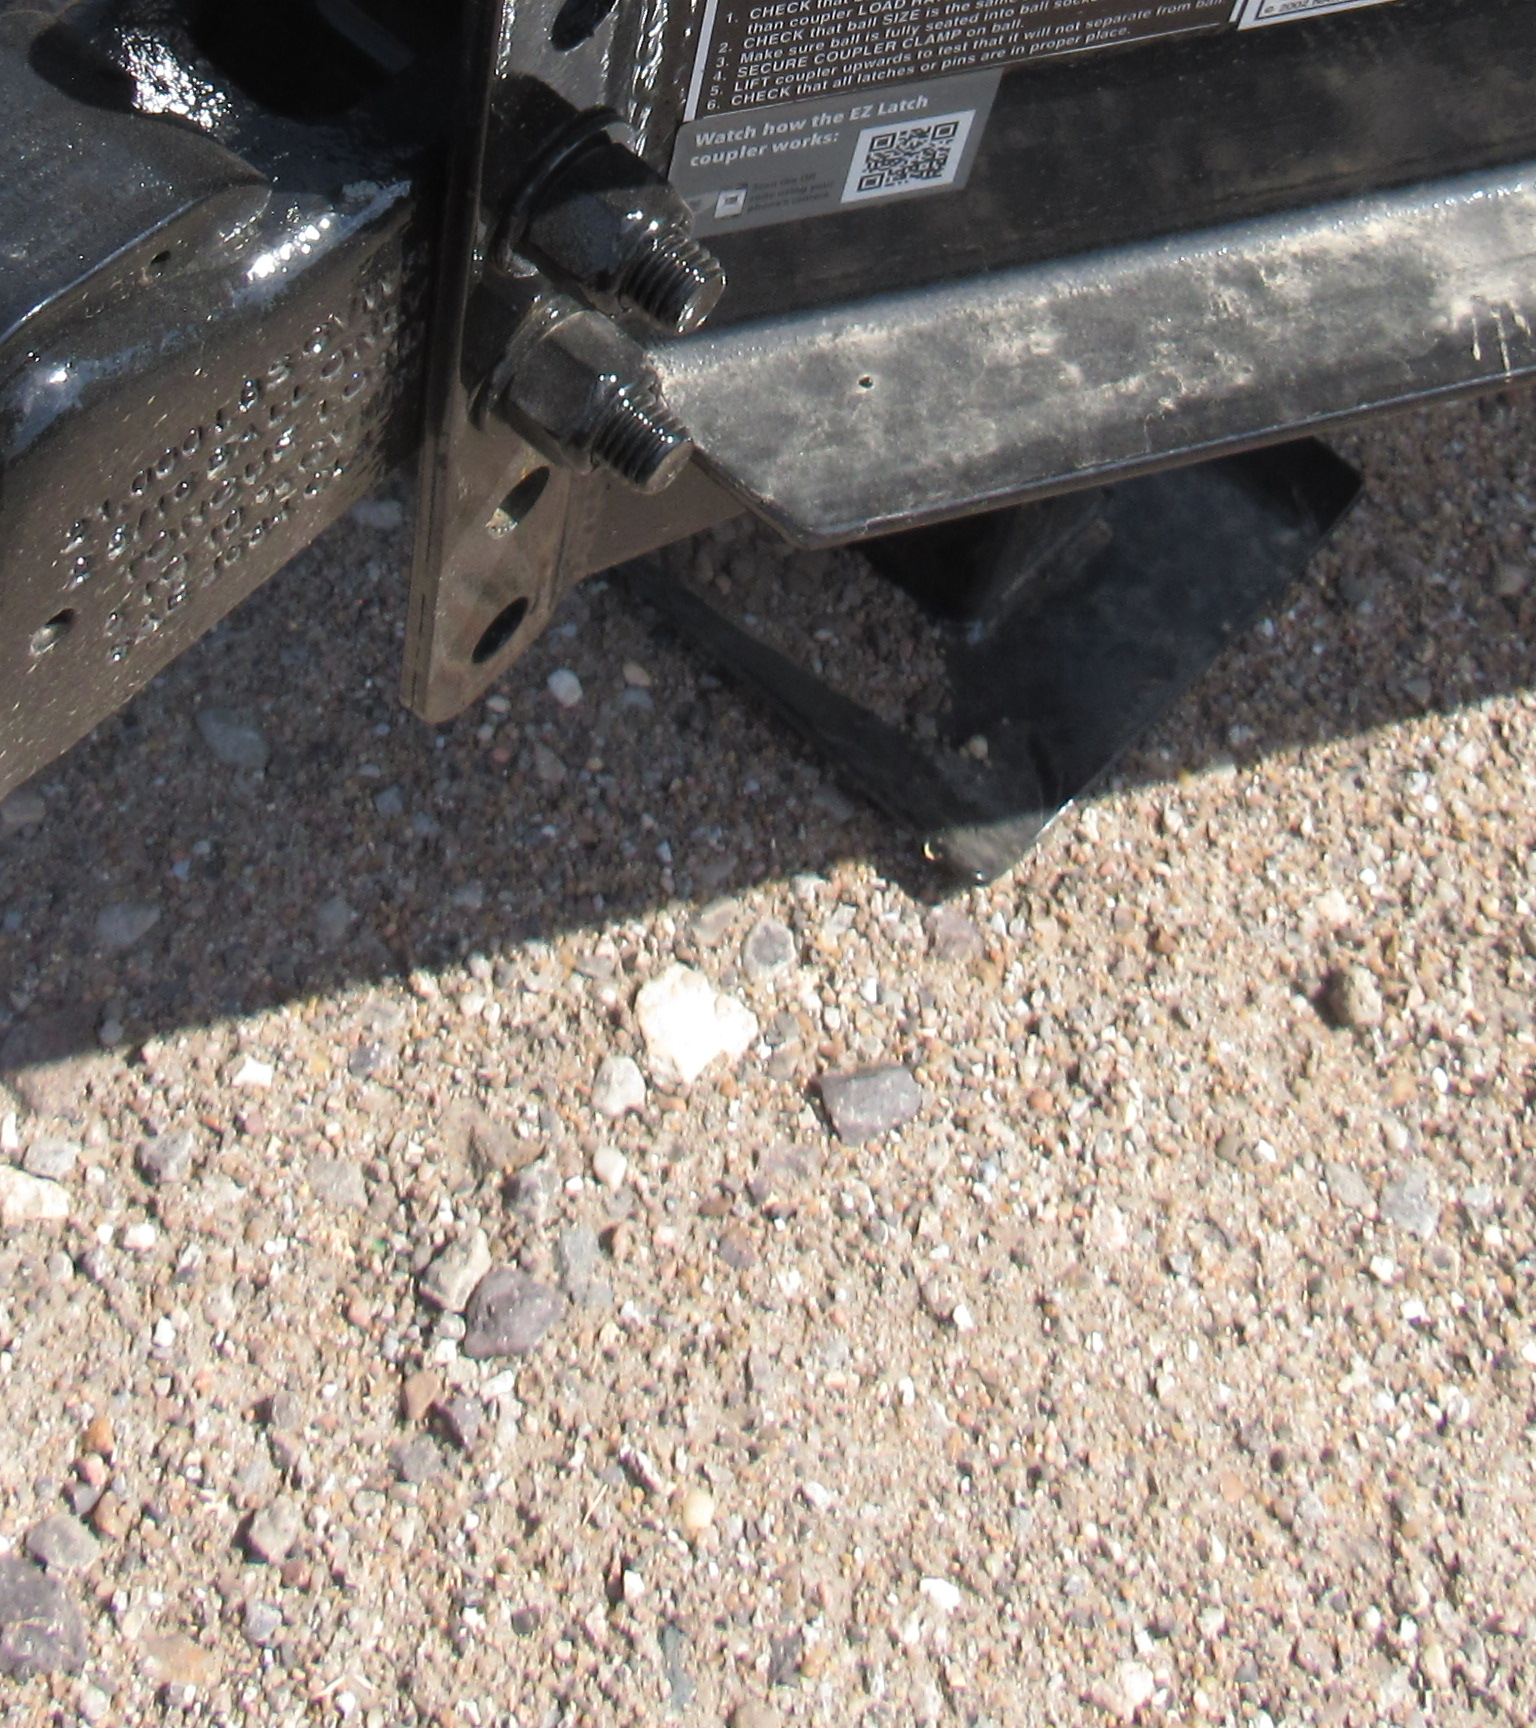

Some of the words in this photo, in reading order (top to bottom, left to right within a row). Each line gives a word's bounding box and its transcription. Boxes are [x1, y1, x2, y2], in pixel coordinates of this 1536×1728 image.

[715, 56, 729, 68] 3.
[739, 48, 783, 63] Make
[788, 41, 825, 55] sure
[829, 33, 860, 48] ball
[864, 31, 879, 42] is
[884, 24, 919, 38] fully
[925, 13, 979, 31] seated
[983, 8, 1015, 21] into
[1019, 0, 1049, 15] ball
[717, 41, 732, 54] 2.
[743, 29, 803, 49] CHECK
[809, 22, 841, 38] that
[846, 16, 877, 31] ball
[882, 8, 920, 25] SIZE
[924, 7, 939, 18] is
[944, 2, 970, 15] the
[727, 11, 738, 24] 1.
[749, 0, 810, 19] CHECK
[747, 20, 784, 34] than
[789, 9, 851, 27] coupler
[706, 98, 720, 110] 6.
[730, 86, 790, 106] CHECK
[796, 80, 827, 94] that
[832, 74, 853, 88] all
[856, 67, 914, 83] latches
[919, 61, 936, 72] or
[940, 54, 975, 70] pins
[980, 49, 1006, 61] are
[1009, 45, 1025, 55] in
[1028, 35, 1080, 54] proper
[1084, 27, 1127, 43] place.
[709, 84, 723, 97] 5.
[733, 76, 768, 92] LIFT
[774, 66, 836, 85] coupler
[842, 54, 911, 73] upwards
[916, 49, 933, 60] to
[937, 41, 968, 56] test
[972, 35, 1004, 50] that
[1007, 32, 1019, 43] it
[1023, 25, 1051, 40] will
[1054, 21, 1080, 34] not
[1085, 10, 1151, 28] separate
[1155, 2, 1191, 16] from
[712, 70, 726, 81] 4.
[737, 55, 806, 78] SECURE
[813, 40, 896, 64] COUPLER
[901, 28, 962, 49] CLAMP
[965, 26, 986, 37] on
[991, 18, 1024, 33] ball.
[695, 125, 756, 146] Watch
[762, 119, 806, 136] how
[811, 112, 844, 127] the
[848, 104, 873, 121] EZ
[877, 95, 928, 115] Latch
[690, 145, 767, 166] coupler
[771, 132, 839, 152] works:
